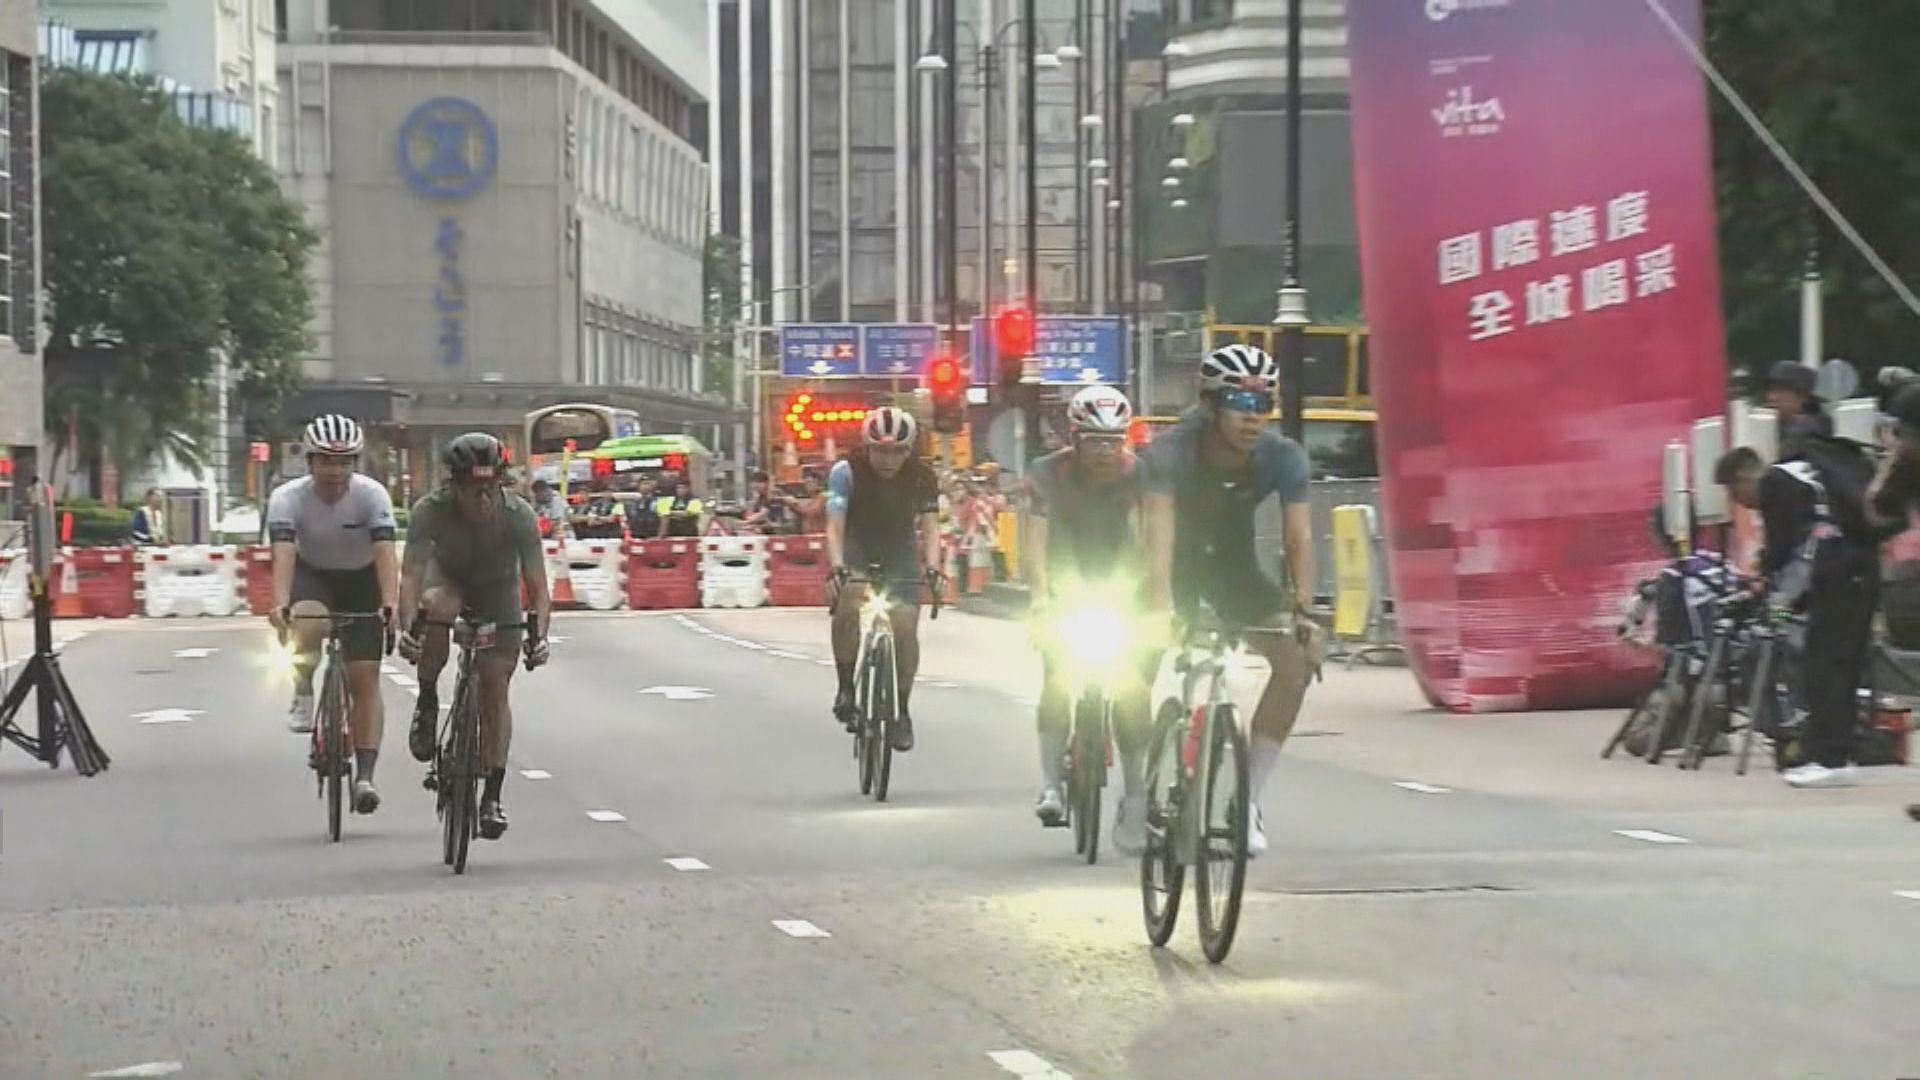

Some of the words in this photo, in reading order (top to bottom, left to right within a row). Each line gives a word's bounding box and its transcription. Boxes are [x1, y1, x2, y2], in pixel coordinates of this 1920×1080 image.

[1437, 190, 1649, 284] 國際速度
[1467, 244, 1676, 341] 全城喝采
